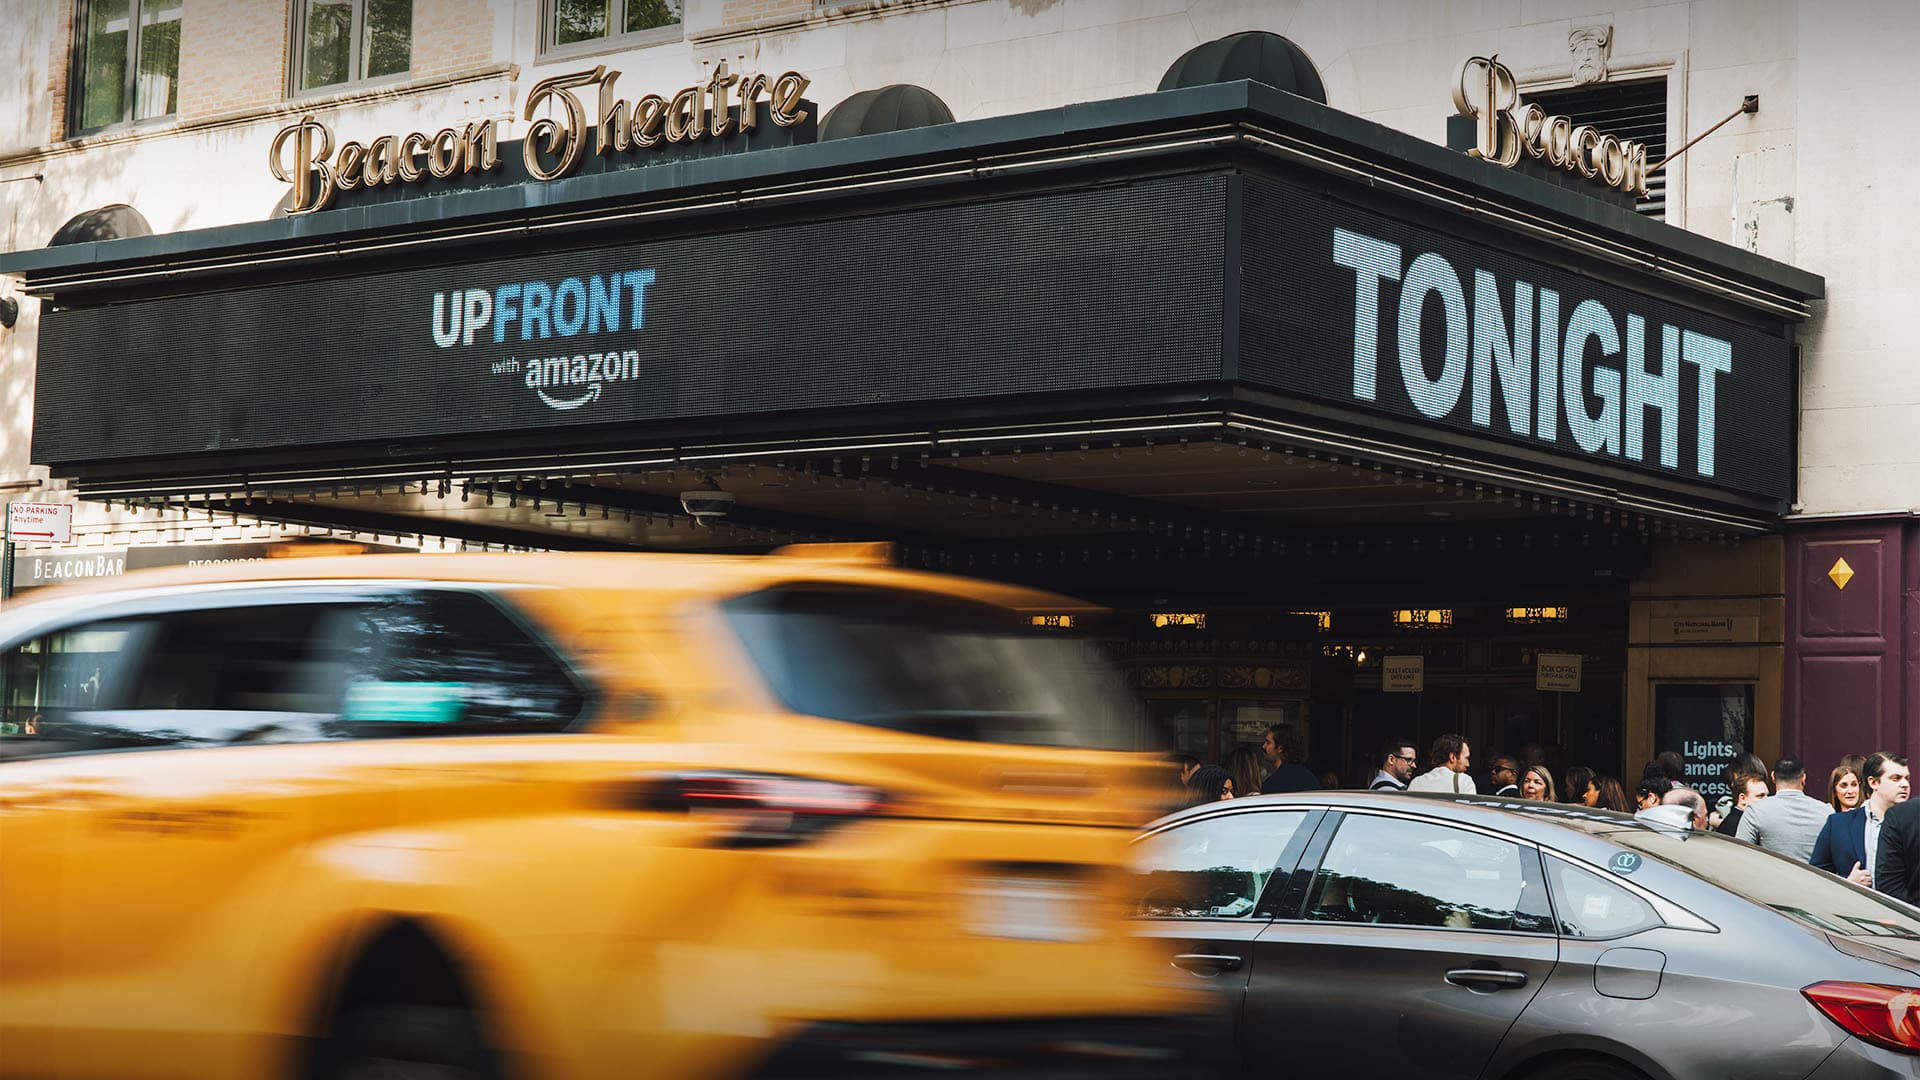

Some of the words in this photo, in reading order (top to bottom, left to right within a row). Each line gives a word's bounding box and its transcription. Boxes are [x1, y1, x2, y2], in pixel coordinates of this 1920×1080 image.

[270, 115, 501, 217] Beacon
[523, 64, 810, 181] Theatre
[1452, 54, 1650, 200] Beacon
[432, 268, 656, 348] UPFRONT
[491, 356, 520, 374] with
[525, 350, 640, 389] amazon
[1332, 227, 1732, 477] TONIGHT
[13, 515, 44, 524] Anytime
[26, 507, 58, 515] PARKING
[1685, 763, 1728, 776] amer
[1686, 782, 1732, 795] ccess
